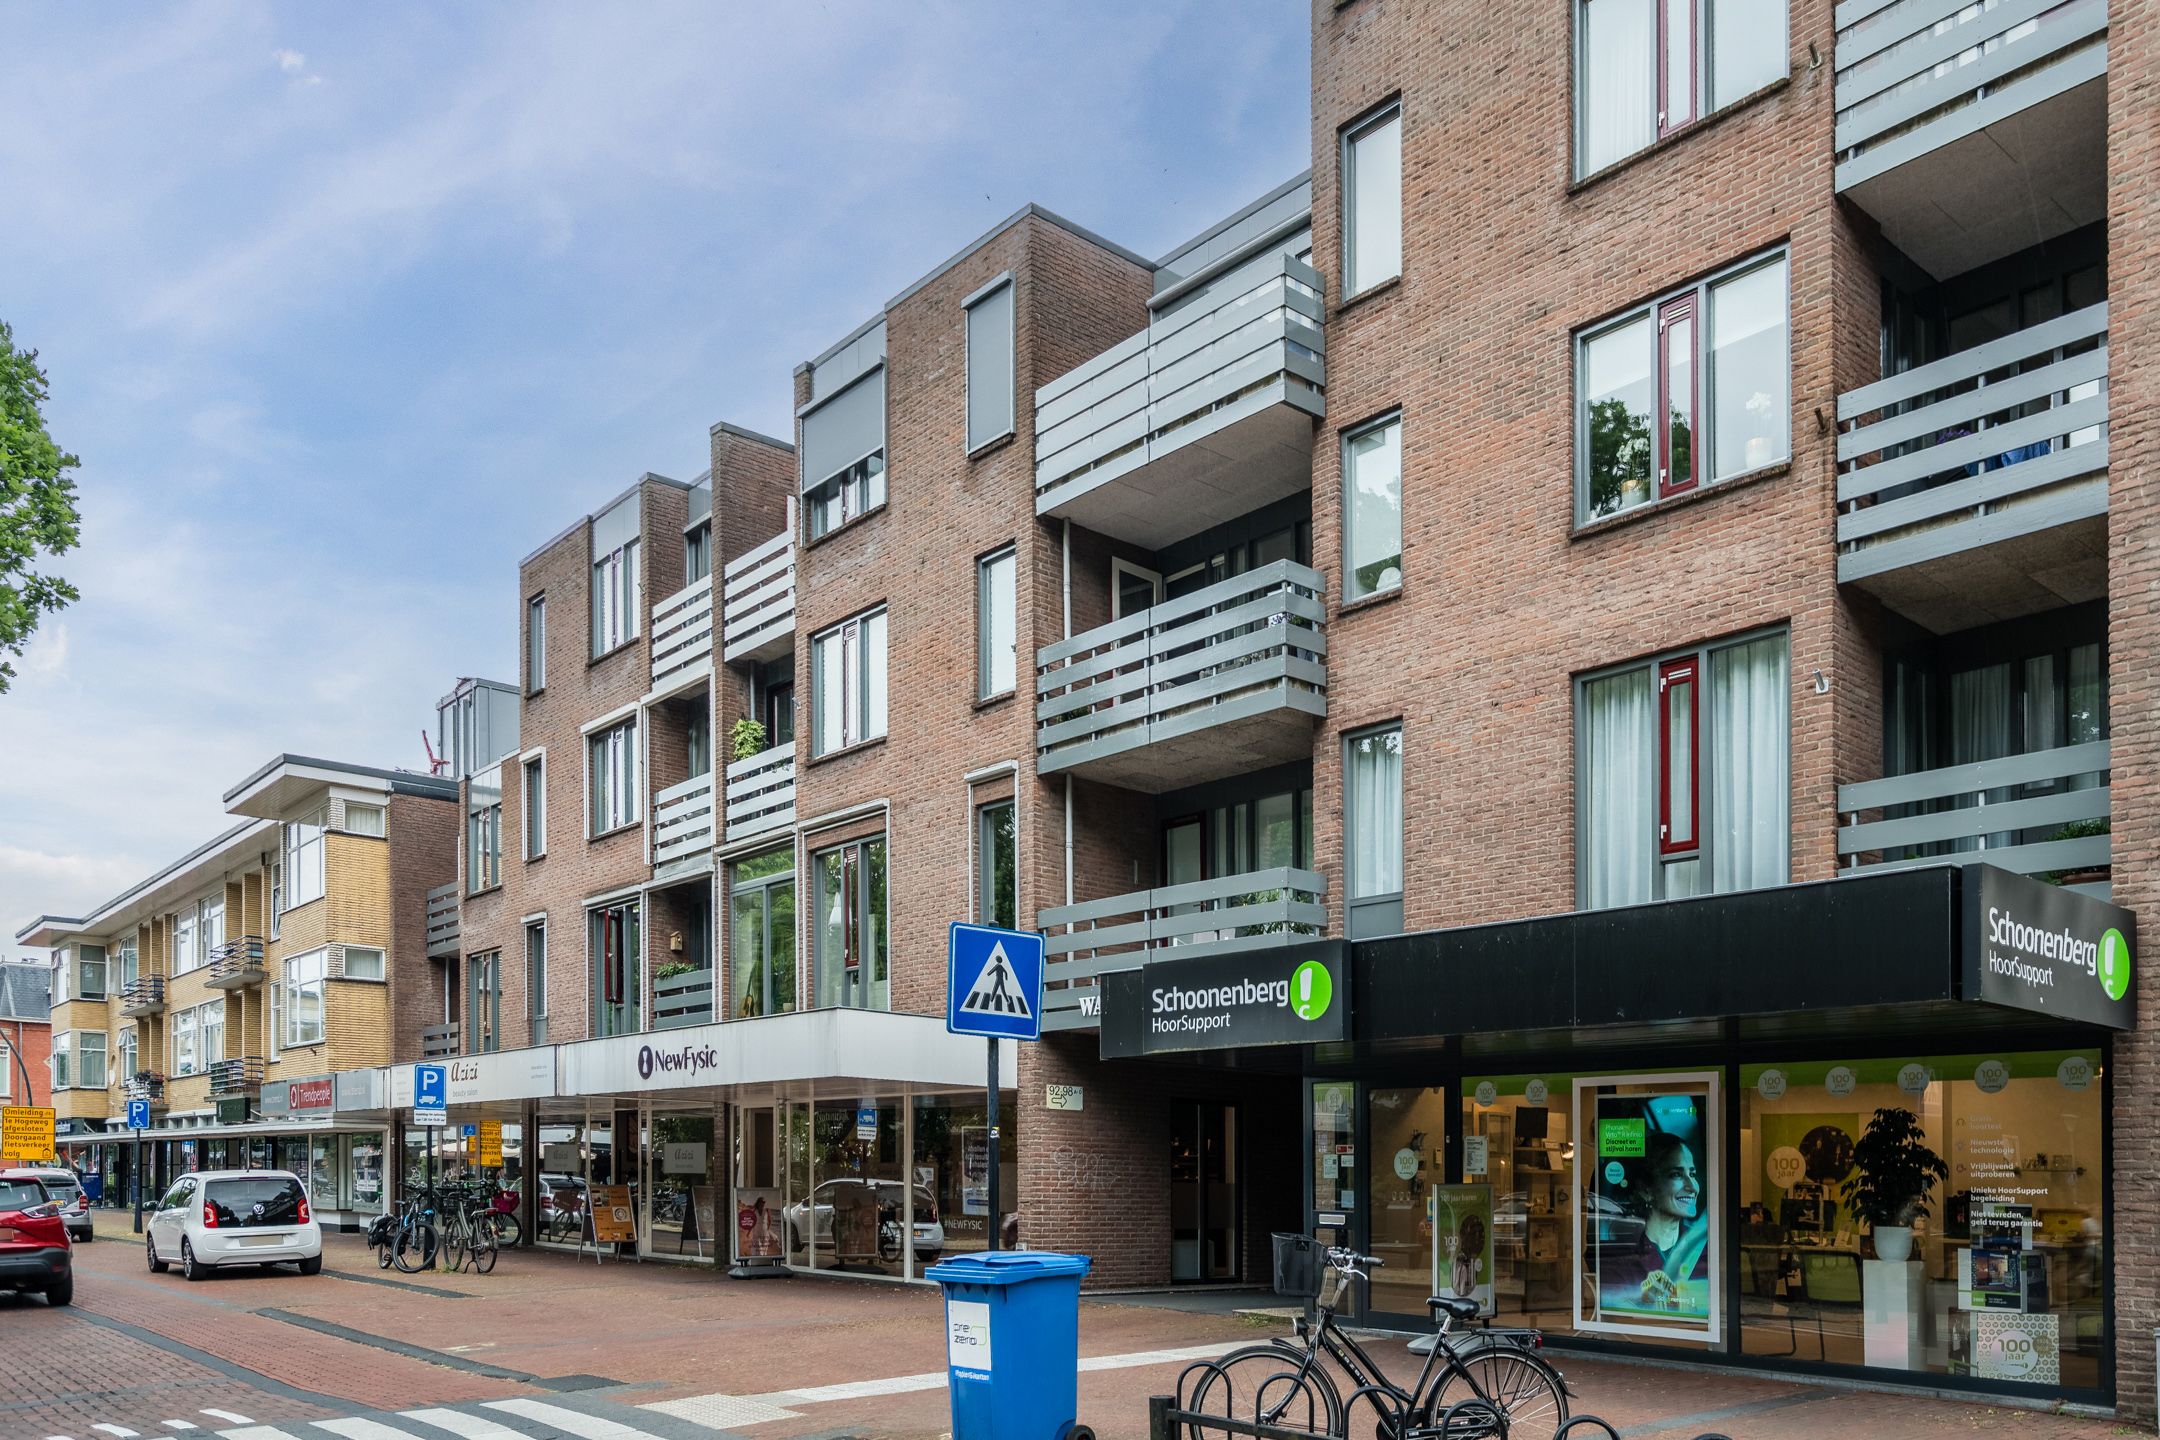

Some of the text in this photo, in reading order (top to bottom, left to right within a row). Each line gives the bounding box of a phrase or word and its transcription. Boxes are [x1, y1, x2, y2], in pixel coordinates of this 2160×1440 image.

[1989, 907, 2097, 976] Schoonenberg
[1989, 950, 2054, 988] HoorSupport
[1152, 978, 1289, 1013] Schoonenberg
[1152, 1012, 1231, 1034] HoorSupport
[655, 1044, 718, 1077] NewFysic
[1981, 1069, 2002, 1078] 100
[2064, 1066, 2087, 1075] 100
[423, 1071, 438, 1090] P
[1763, 1077, 1781, 1085] 100
[1832, 1074, 1850, 1083] 100
[1904, 1072, 1923, 1081] 100
[300, 1084, 331, 1105] Trendpeople
[5, 1109, 44, 1117] Omleiding
[132, 1103, 144, 1117] P
[15, 1118, 49, 1126] Hogeweg
[4, 1150, 20, 1158] volg
[1399, 1156, 1414, 1164] 100
[1772, 1158, 1800, 1170] 100
[1970, 1163, 2014, 1171] Vrijblijvend
[1777, 1170, 1795, 1179] jaar
[1970, 1171, 2015, 1179] uitproberen
[1970, 1186, 2048, 1196] Unieke HoorSupport
[1970, 1195, 2015, 1204] begeleiding
[1970, 1210, 2024, 1219] Niet tevreden,
[944, 1219, 983, 1230] #NEWFYSIC
[1970, 1219, 2043, 1228] geld terug garantie
[1444, 1236, 1458, 1246] 100
[953, 1335, 977, 1345] zero
[1998, 1340, 2031, 1352] 100
[2004, 1351, 2027, 1361] jaar
